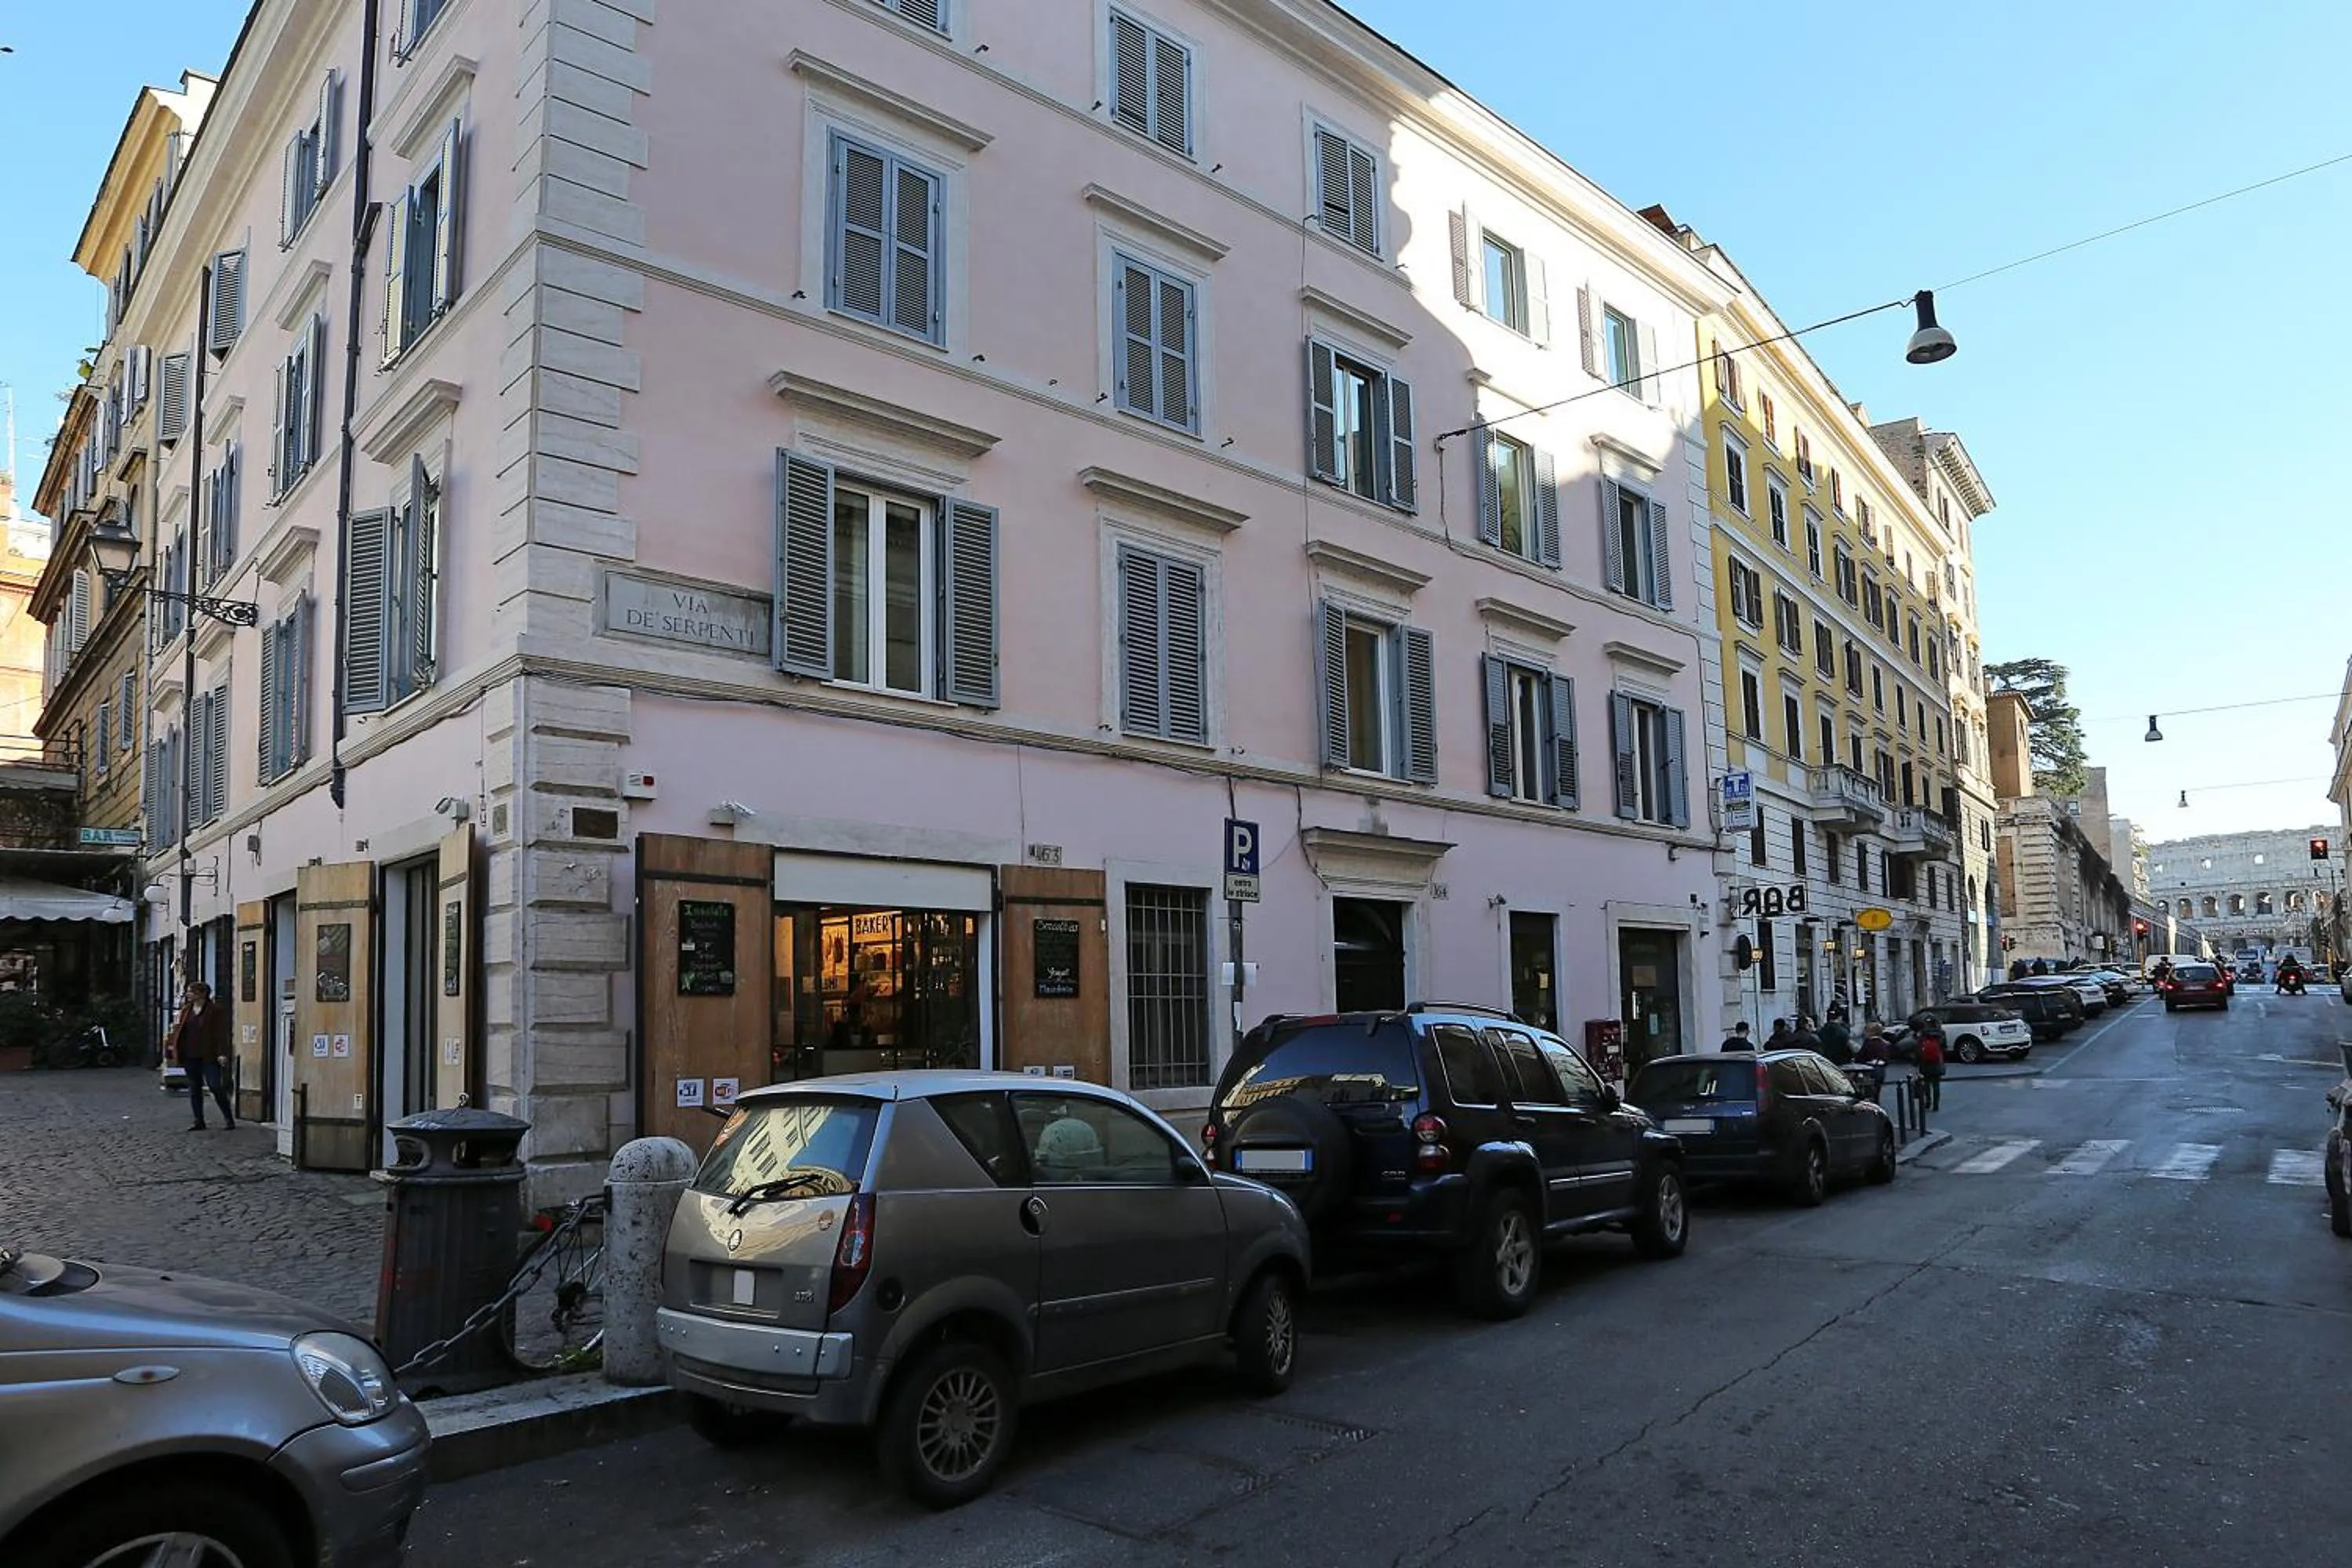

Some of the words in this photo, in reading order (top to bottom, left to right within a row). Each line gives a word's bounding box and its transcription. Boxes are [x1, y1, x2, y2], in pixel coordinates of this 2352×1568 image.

[673, 593, 708, 614] VIA
[662, 615, 754, 646] SERPENTI
[82, 829, 113, 841] BAR
[1233, 826, 1252, 869] P
